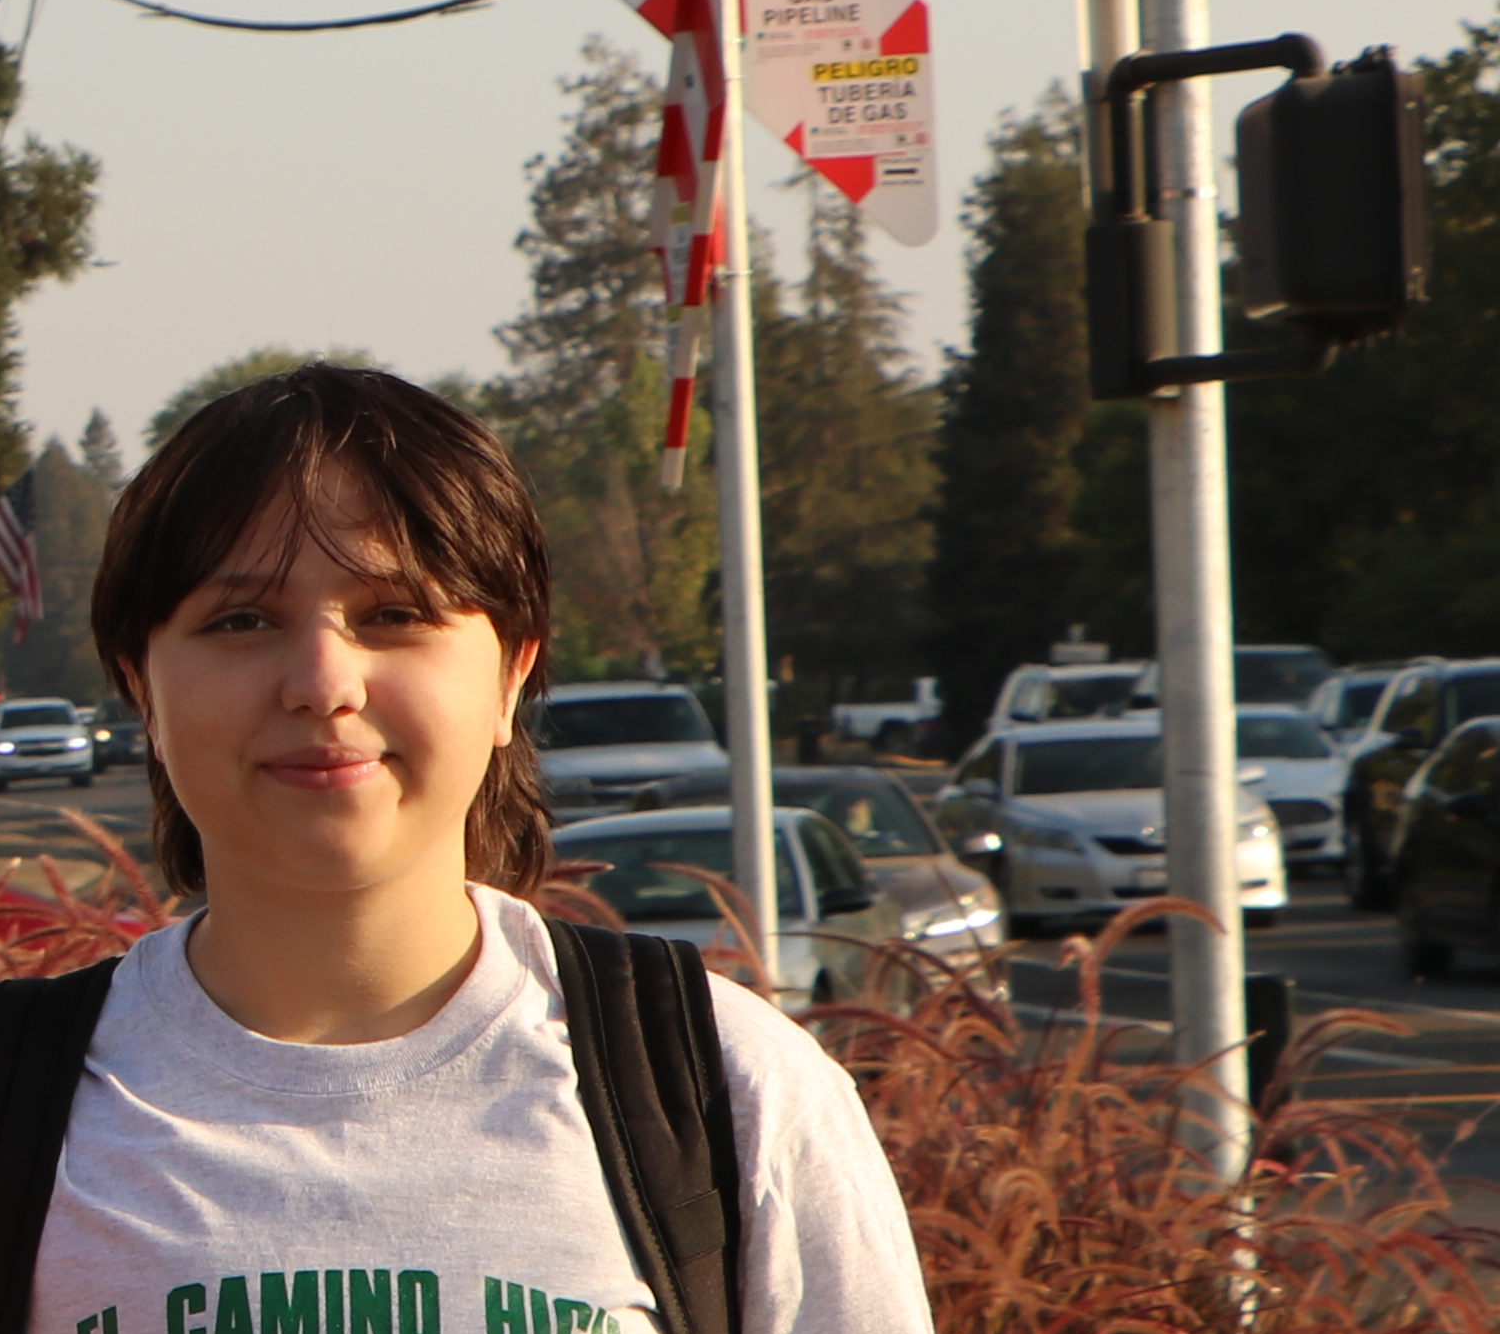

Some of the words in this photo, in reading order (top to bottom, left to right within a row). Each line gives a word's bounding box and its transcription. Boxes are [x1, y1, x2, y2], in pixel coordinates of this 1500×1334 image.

[764, 3, 860, 25] PIPELINE
[814, 57, 918, 80] PELIGRO
[828, 105, 856, 124] DE
[862, 102, 908, 121] GAS
